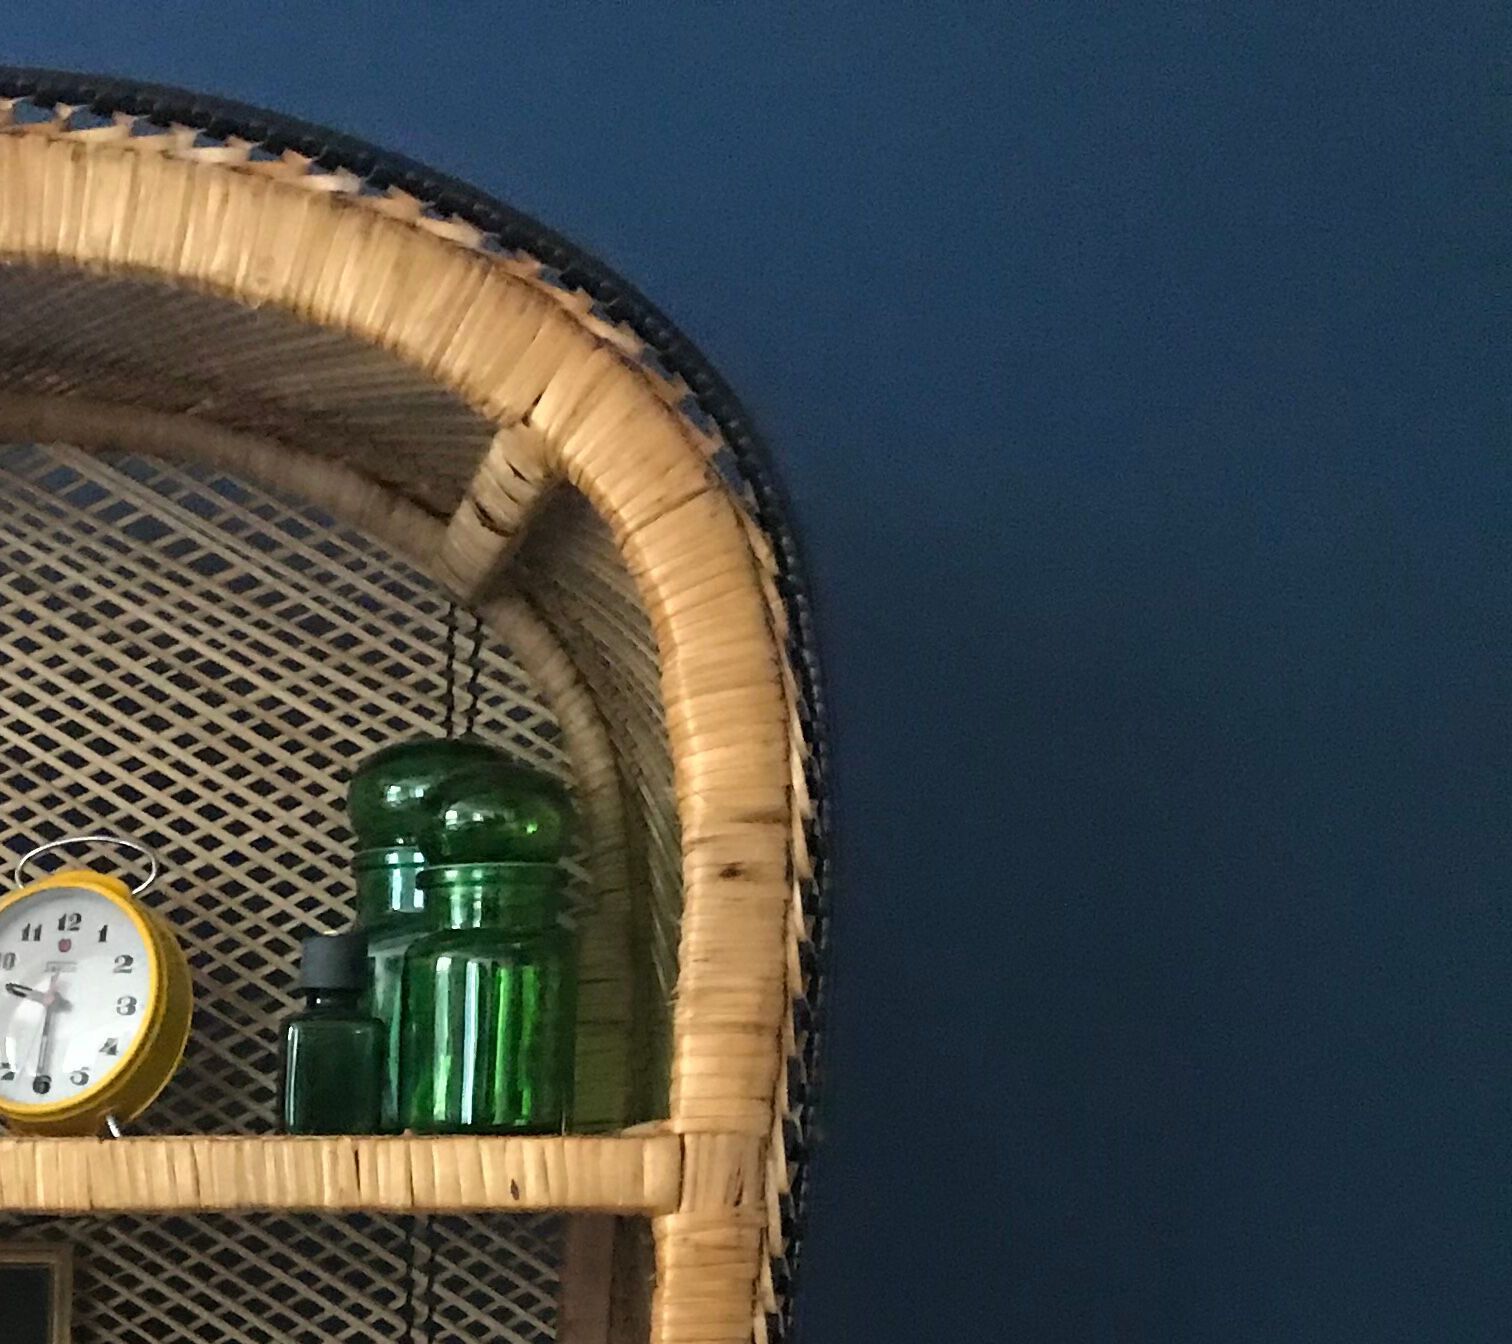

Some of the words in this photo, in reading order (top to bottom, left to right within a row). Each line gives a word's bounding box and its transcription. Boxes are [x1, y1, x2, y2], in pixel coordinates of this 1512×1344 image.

[57, 912, 82, 931] 12
[21, 923, 43, 941] 11
[98, 924, 109, 942] 1
[113, 954, 134, 974] 2
[116, 996, 137, 1015] 3
[98, 1038, 119, 1056] 4
[33, 1075, 52, 1095] 6
[70, 1066, 90, 1086] 5
